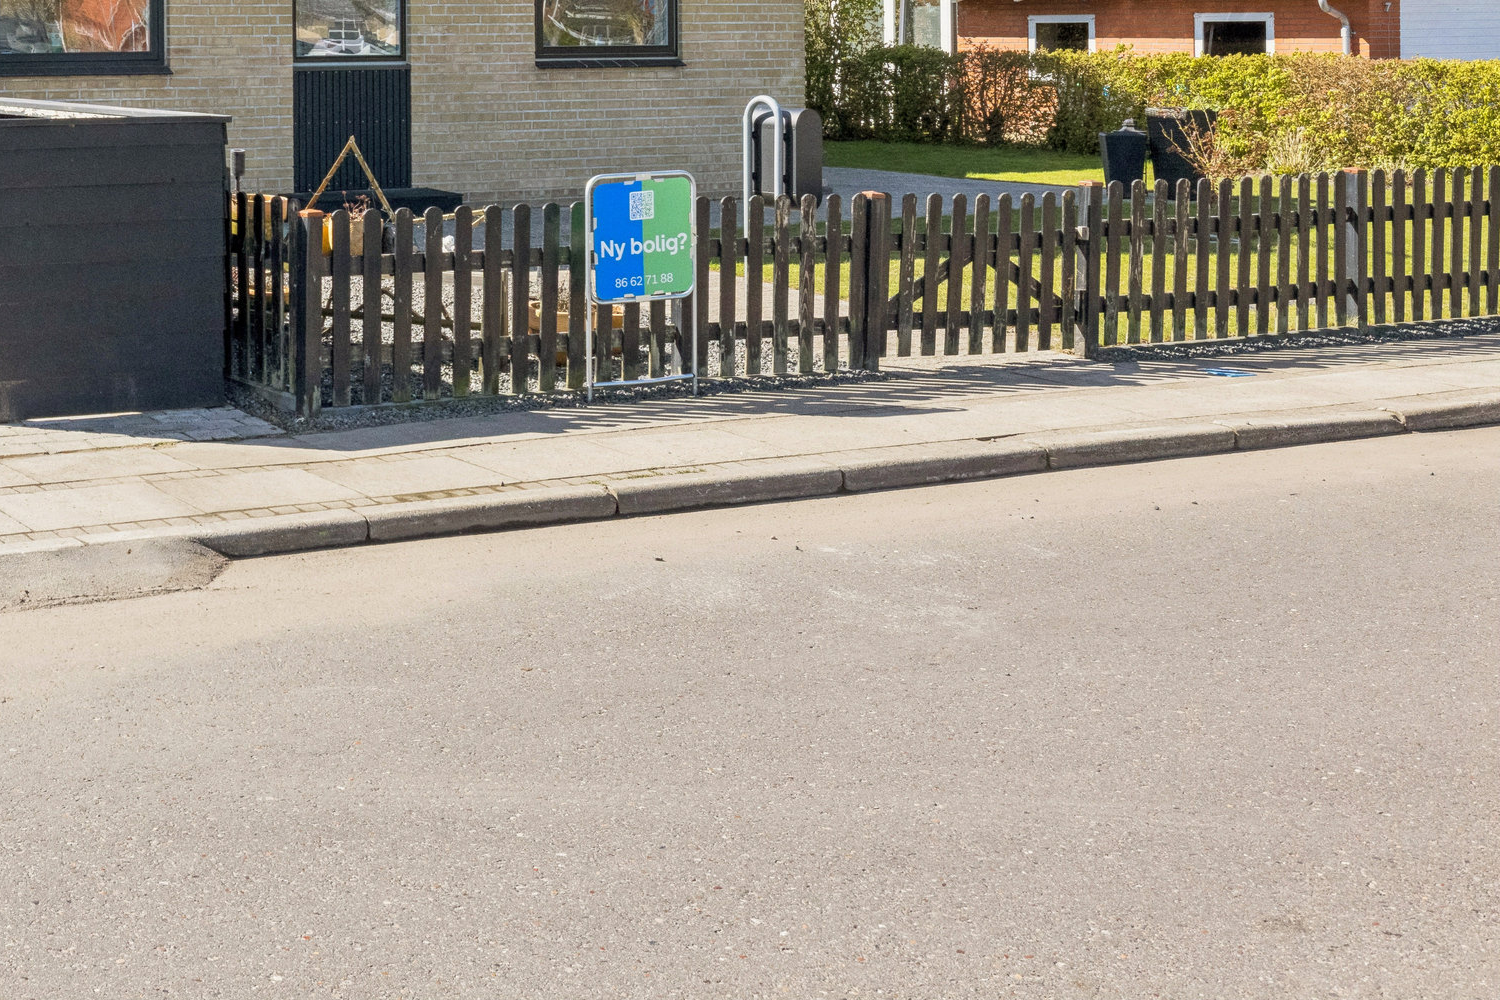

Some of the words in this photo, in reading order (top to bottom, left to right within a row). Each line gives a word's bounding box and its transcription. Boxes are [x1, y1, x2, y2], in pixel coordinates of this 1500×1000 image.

[1385, 2, 1392, 12] 7
[600, 240, 626, 261] Ny
[630, 232, 688, 256] bolig?
[615, 277, 628, 288] 86
[630, 275, 643, 287] 62
[645, 274, 658, 285] 71
[660, 272, 674, 283] 88
